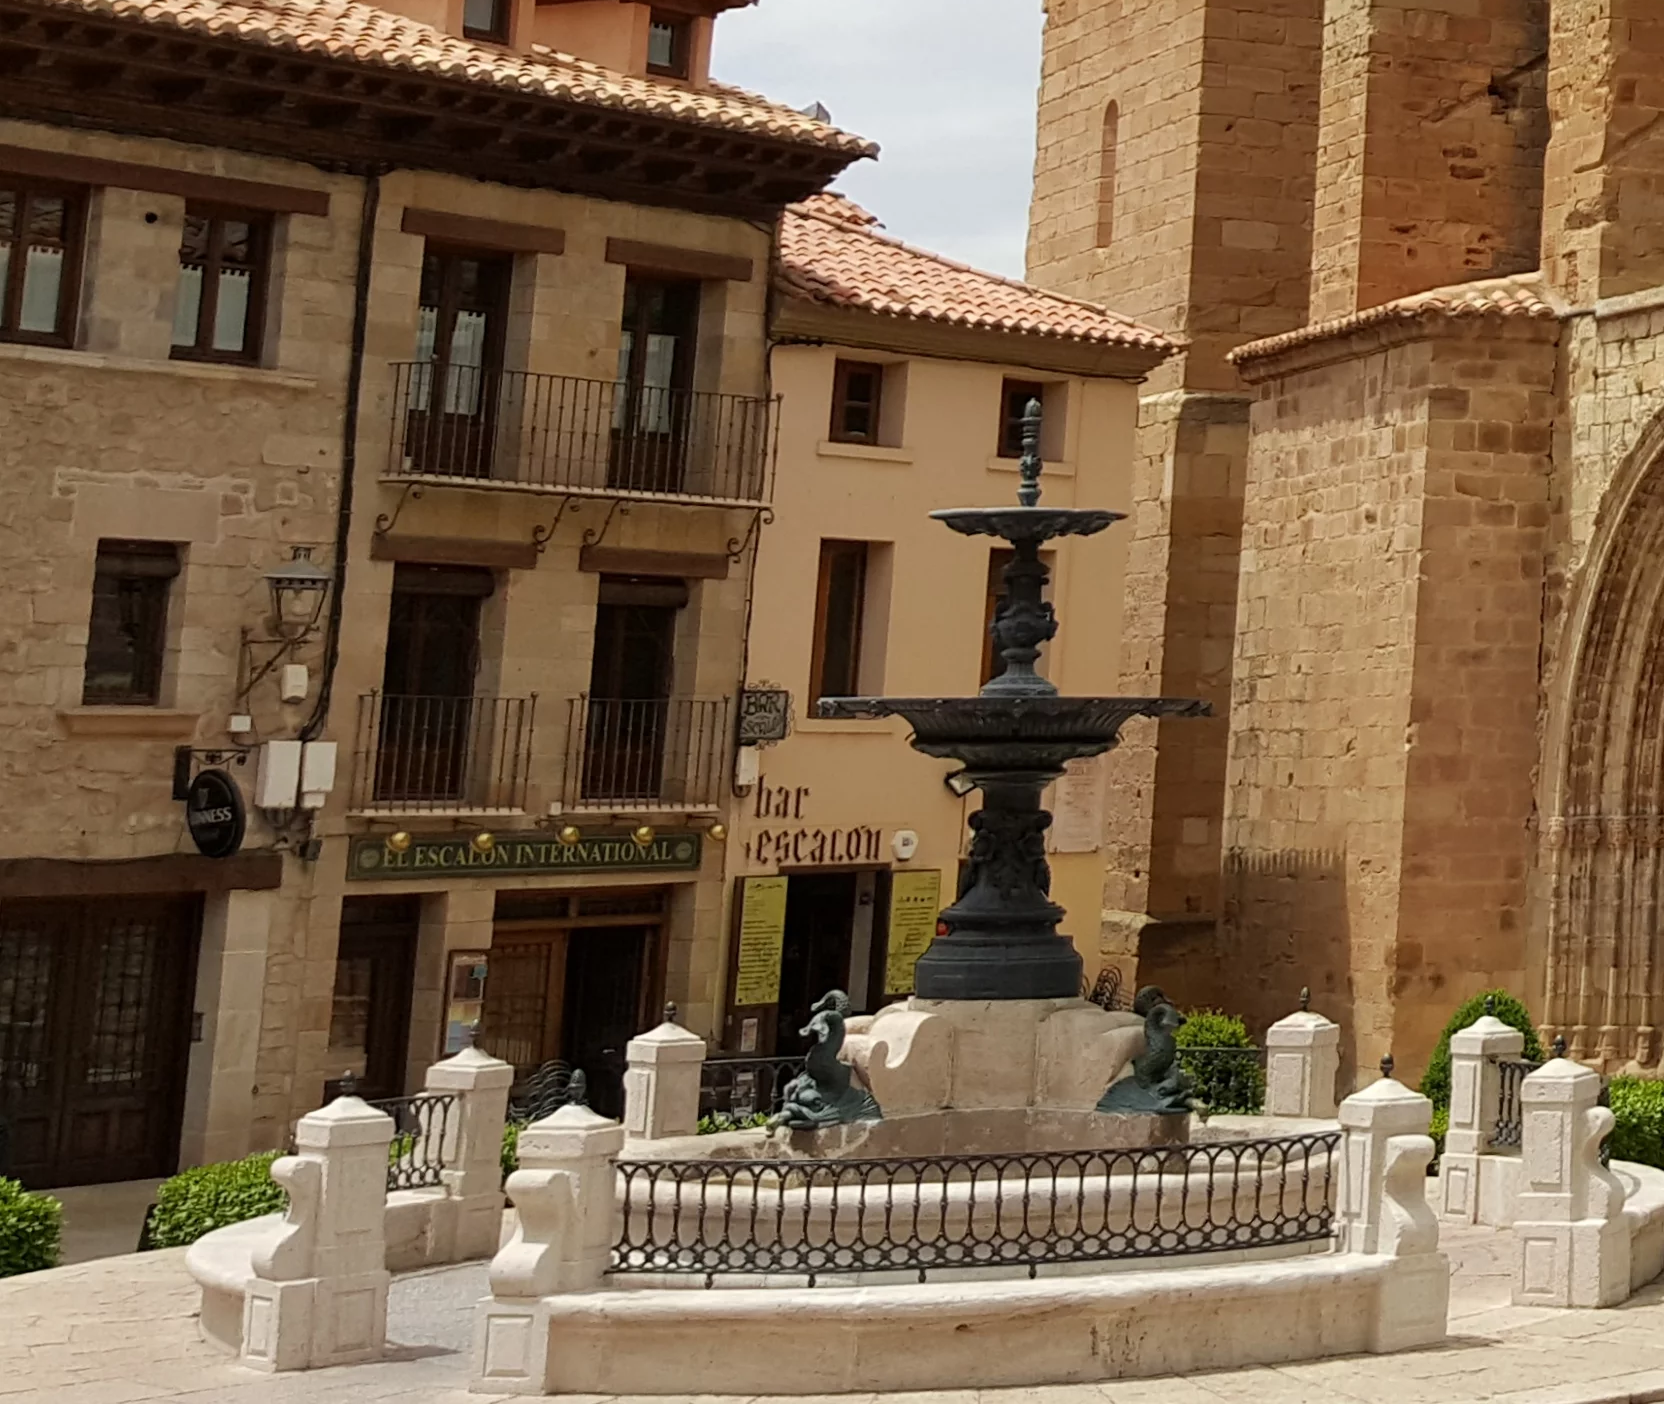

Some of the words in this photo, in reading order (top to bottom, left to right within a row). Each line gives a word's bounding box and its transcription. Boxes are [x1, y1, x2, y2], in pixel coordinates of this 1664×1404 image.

[743, 692, 781, 715] BAR
[754, 773, 810, 819] bar
[383, 847, 409, 868] EL
[515, 840, 672, 864] INTERNATIONAL
[755, 825, 882, 864] escalón
